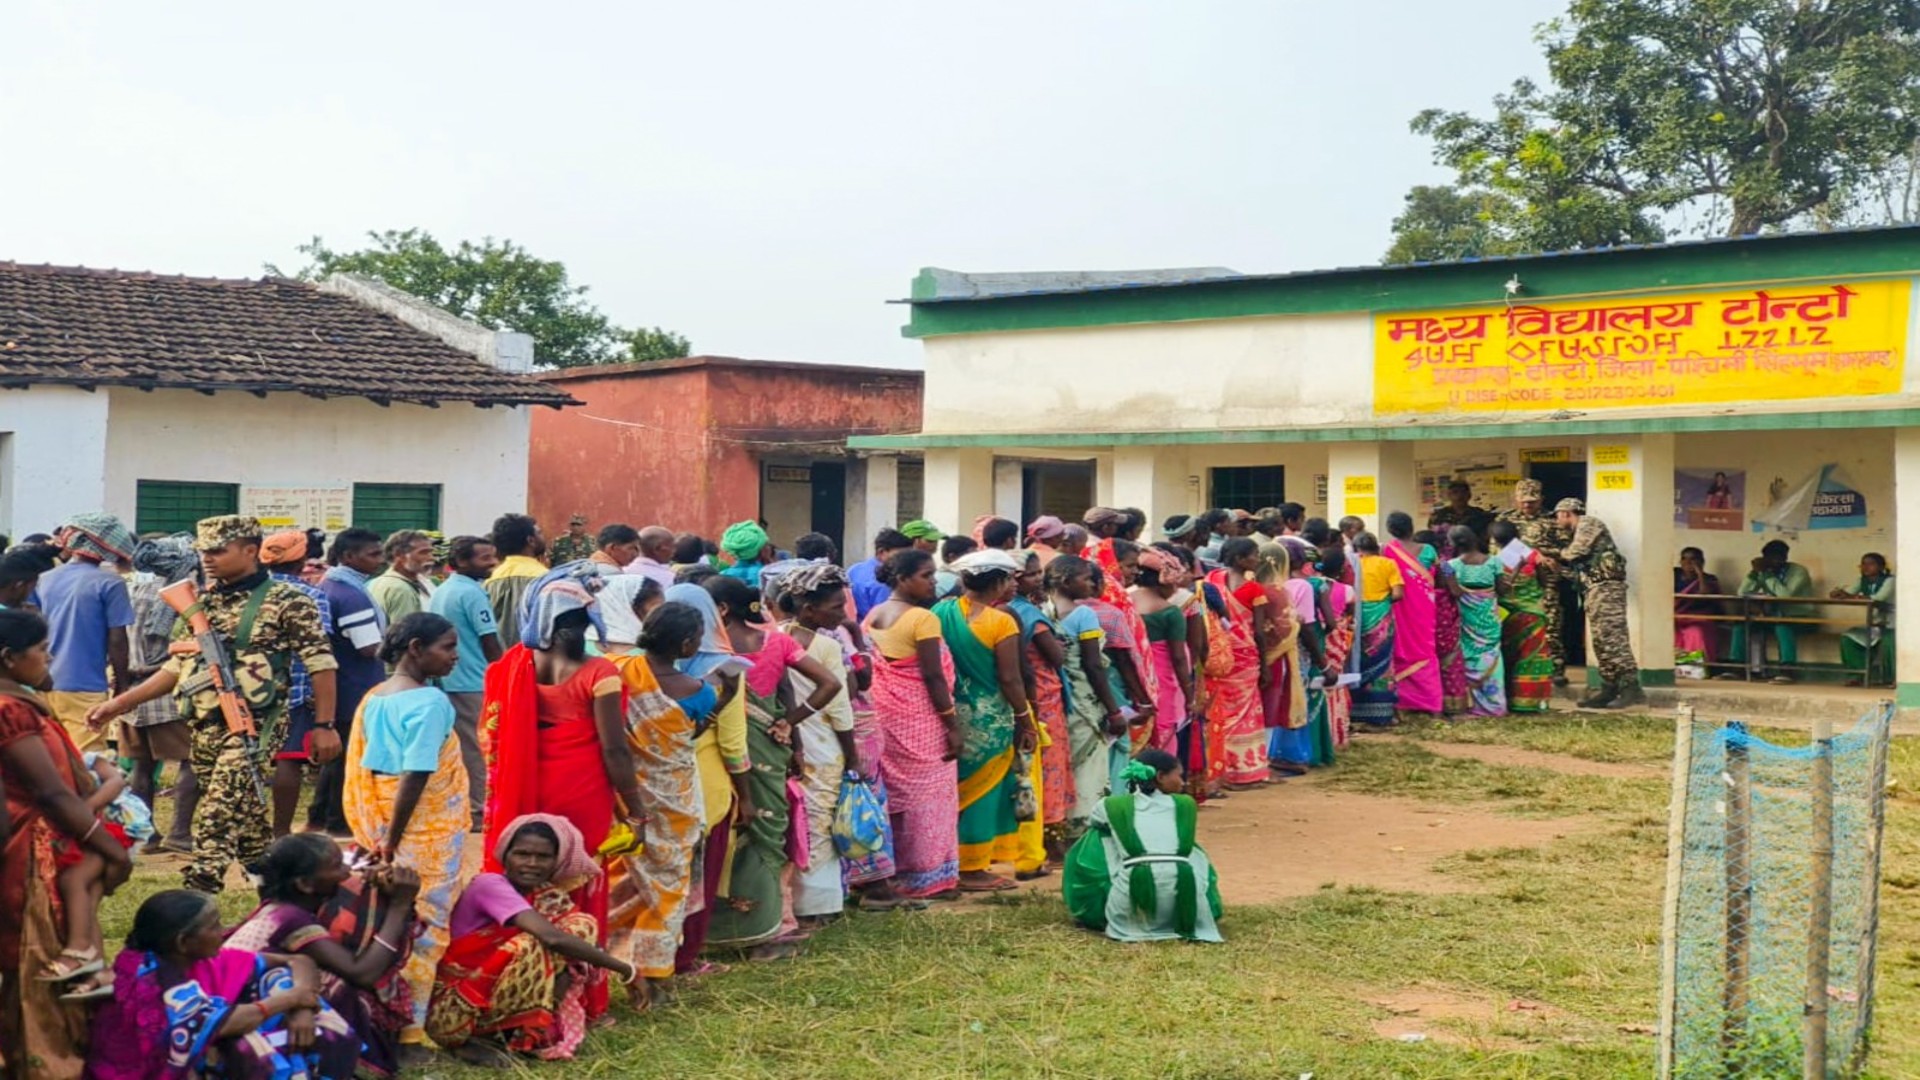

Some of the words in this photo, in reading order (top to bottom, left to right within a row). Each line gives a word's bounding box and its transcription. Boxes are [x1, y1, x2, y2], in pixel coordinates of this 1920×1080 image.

[1387, 313, 1493, 344] मध्य
[1498, 301, 1702, 337] विद्यालय
[1721, 284, 1858, 327] टोन्टो
[480, 609, 491, 623] 3
